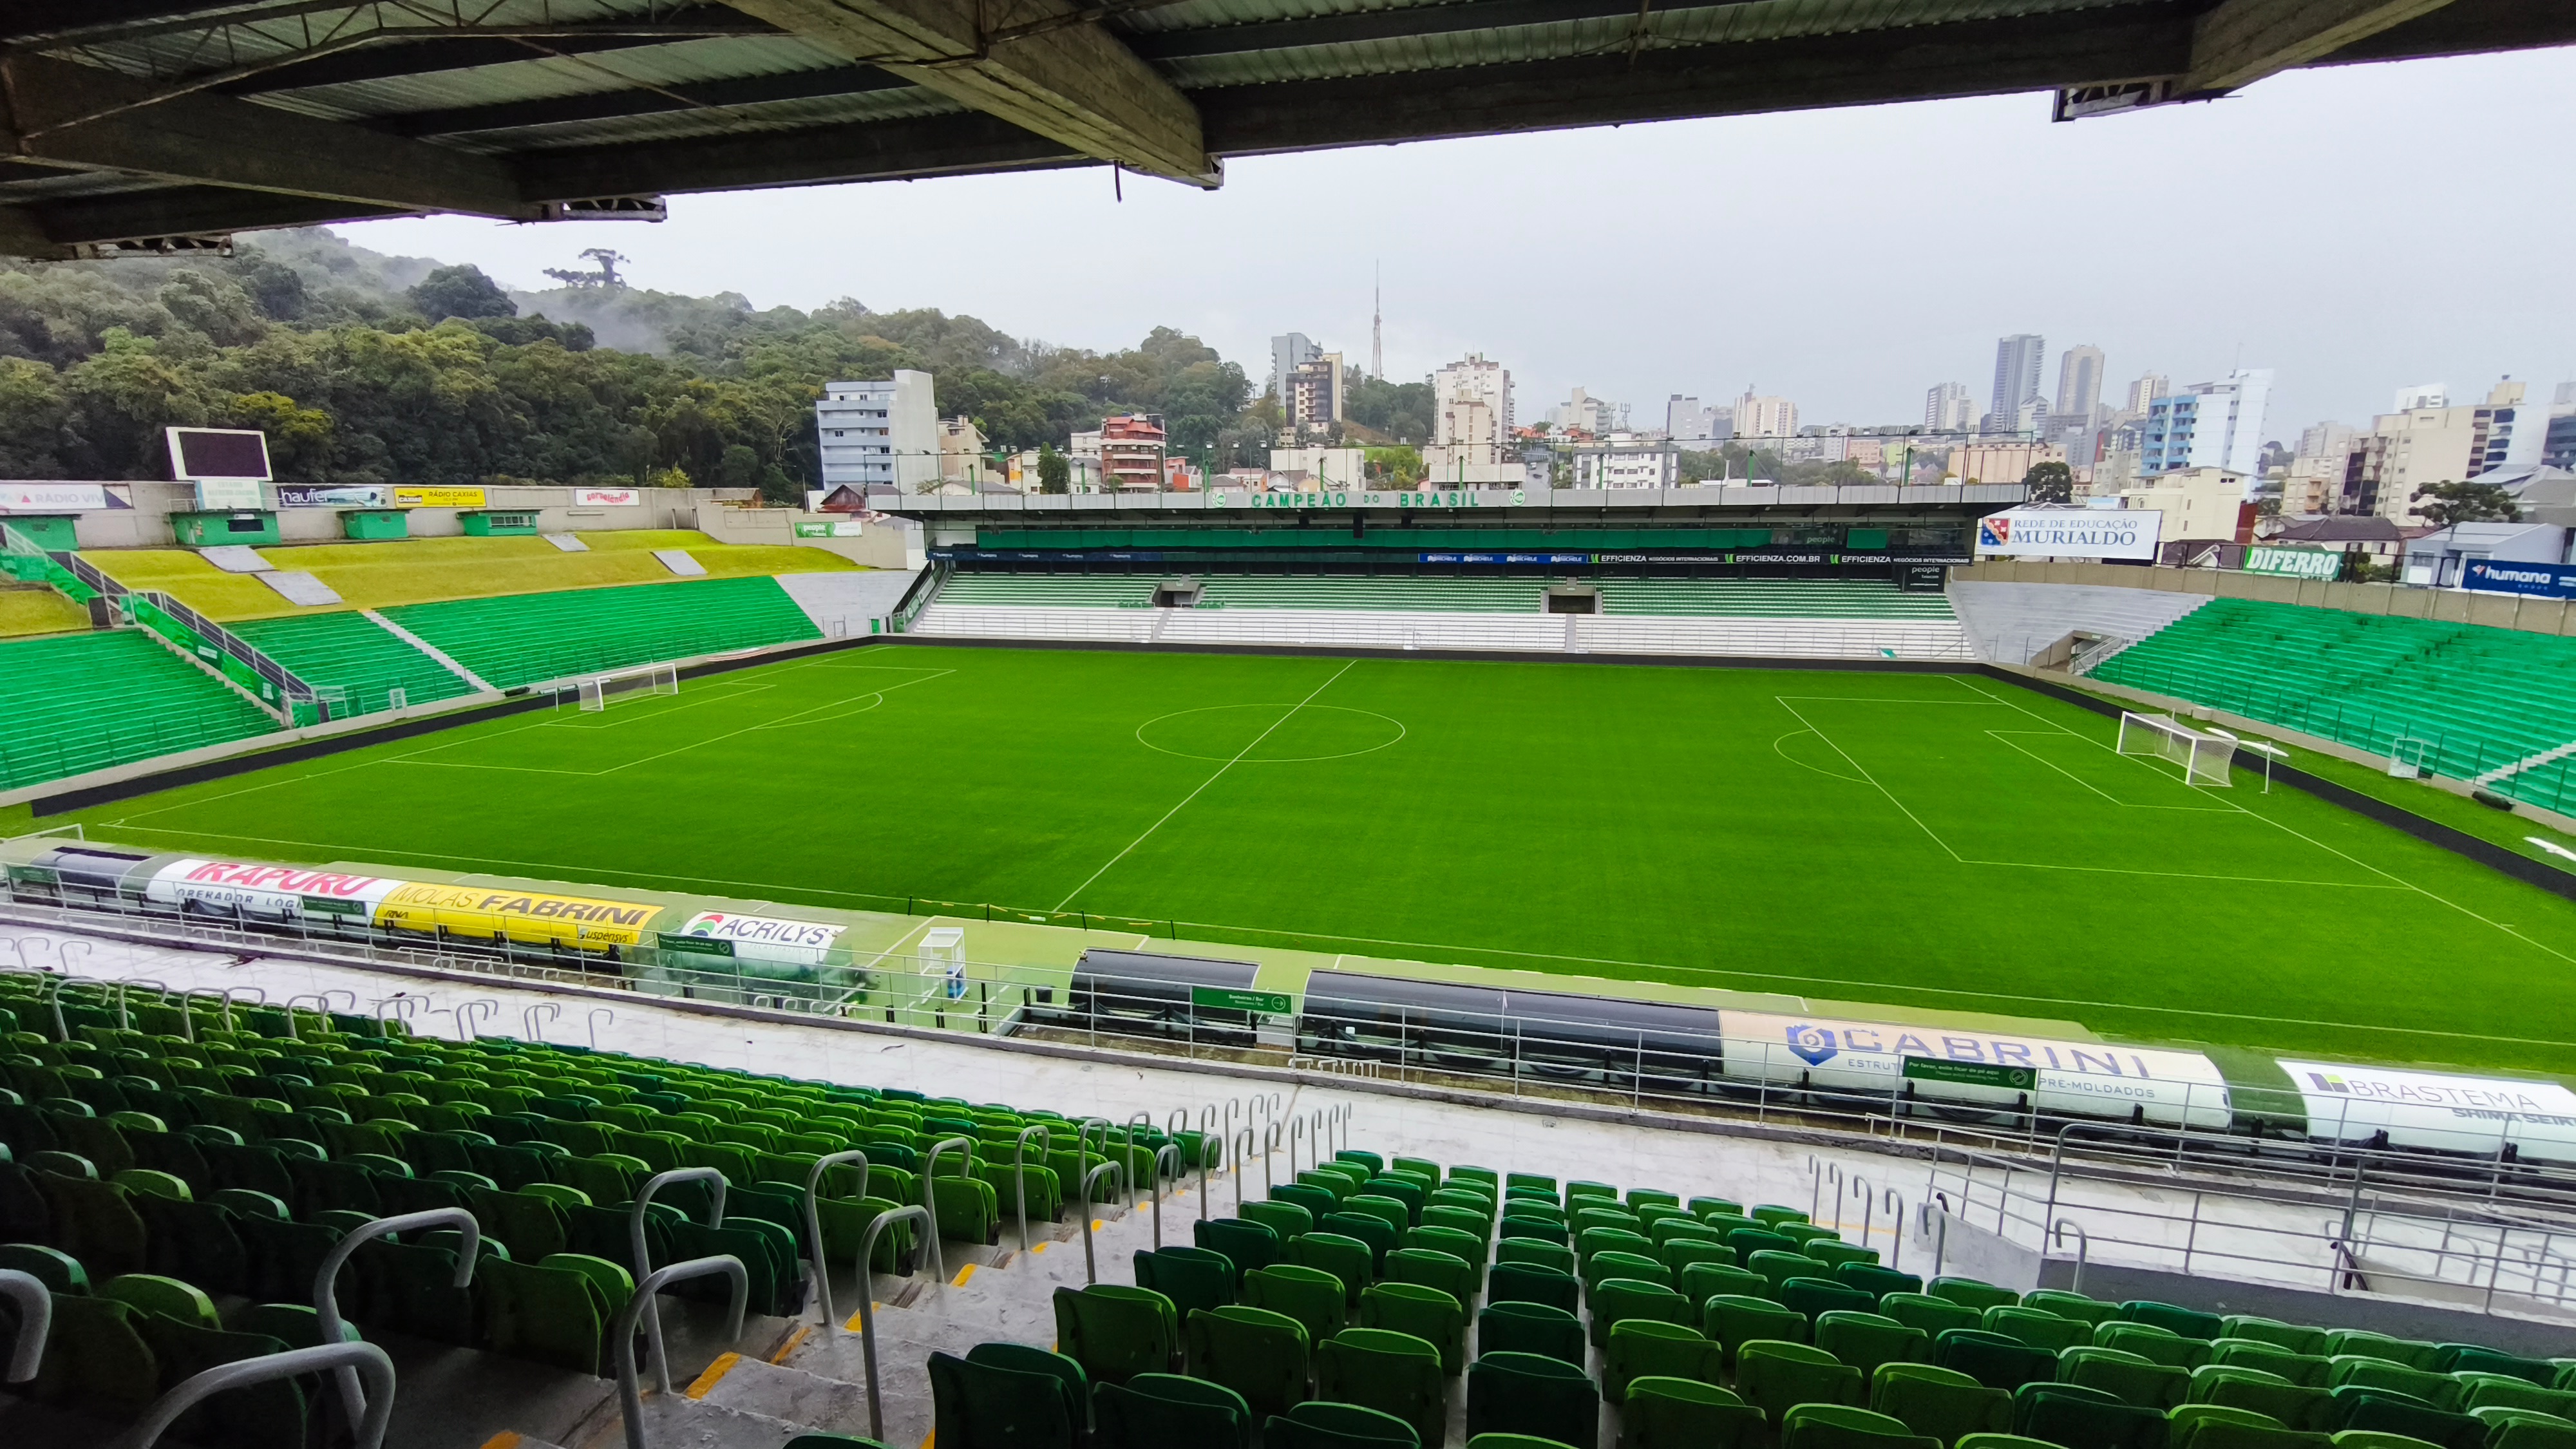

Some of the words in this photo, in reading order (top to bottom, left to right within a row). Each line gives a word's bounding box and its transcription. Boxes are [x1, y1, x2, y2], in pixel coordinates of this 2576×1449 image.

[35, 493, 79, 503] RÁDIO
[1252, 491, 1346, 507] CAMPEÃO
[1364, 495, 1379, 503] DO
[1400, 492, 1479, 507] BRASIL
[2014, 520, 2045, 528] REDE
[2070, 518, 2137, 531] EDUCAÇÃO
[1806, 535, 1835, 544] people
[2012, 531, 2136, 545] MURIALDO
[2246, 549, 2339, 575] DIFERRO
[2485, 565, 2551, 584] humana
[185, 862, 381, 896] IRAPURU
[392, 886, 480, 907] MOLAS
[477, 895, 649, 925] FABRINI
[717, 919, 829, 945] ACRILYS
[1843, 1027, 2150, 1077] CABRINI
[2348, 1080, 2543, 1111] BRASTEMA
